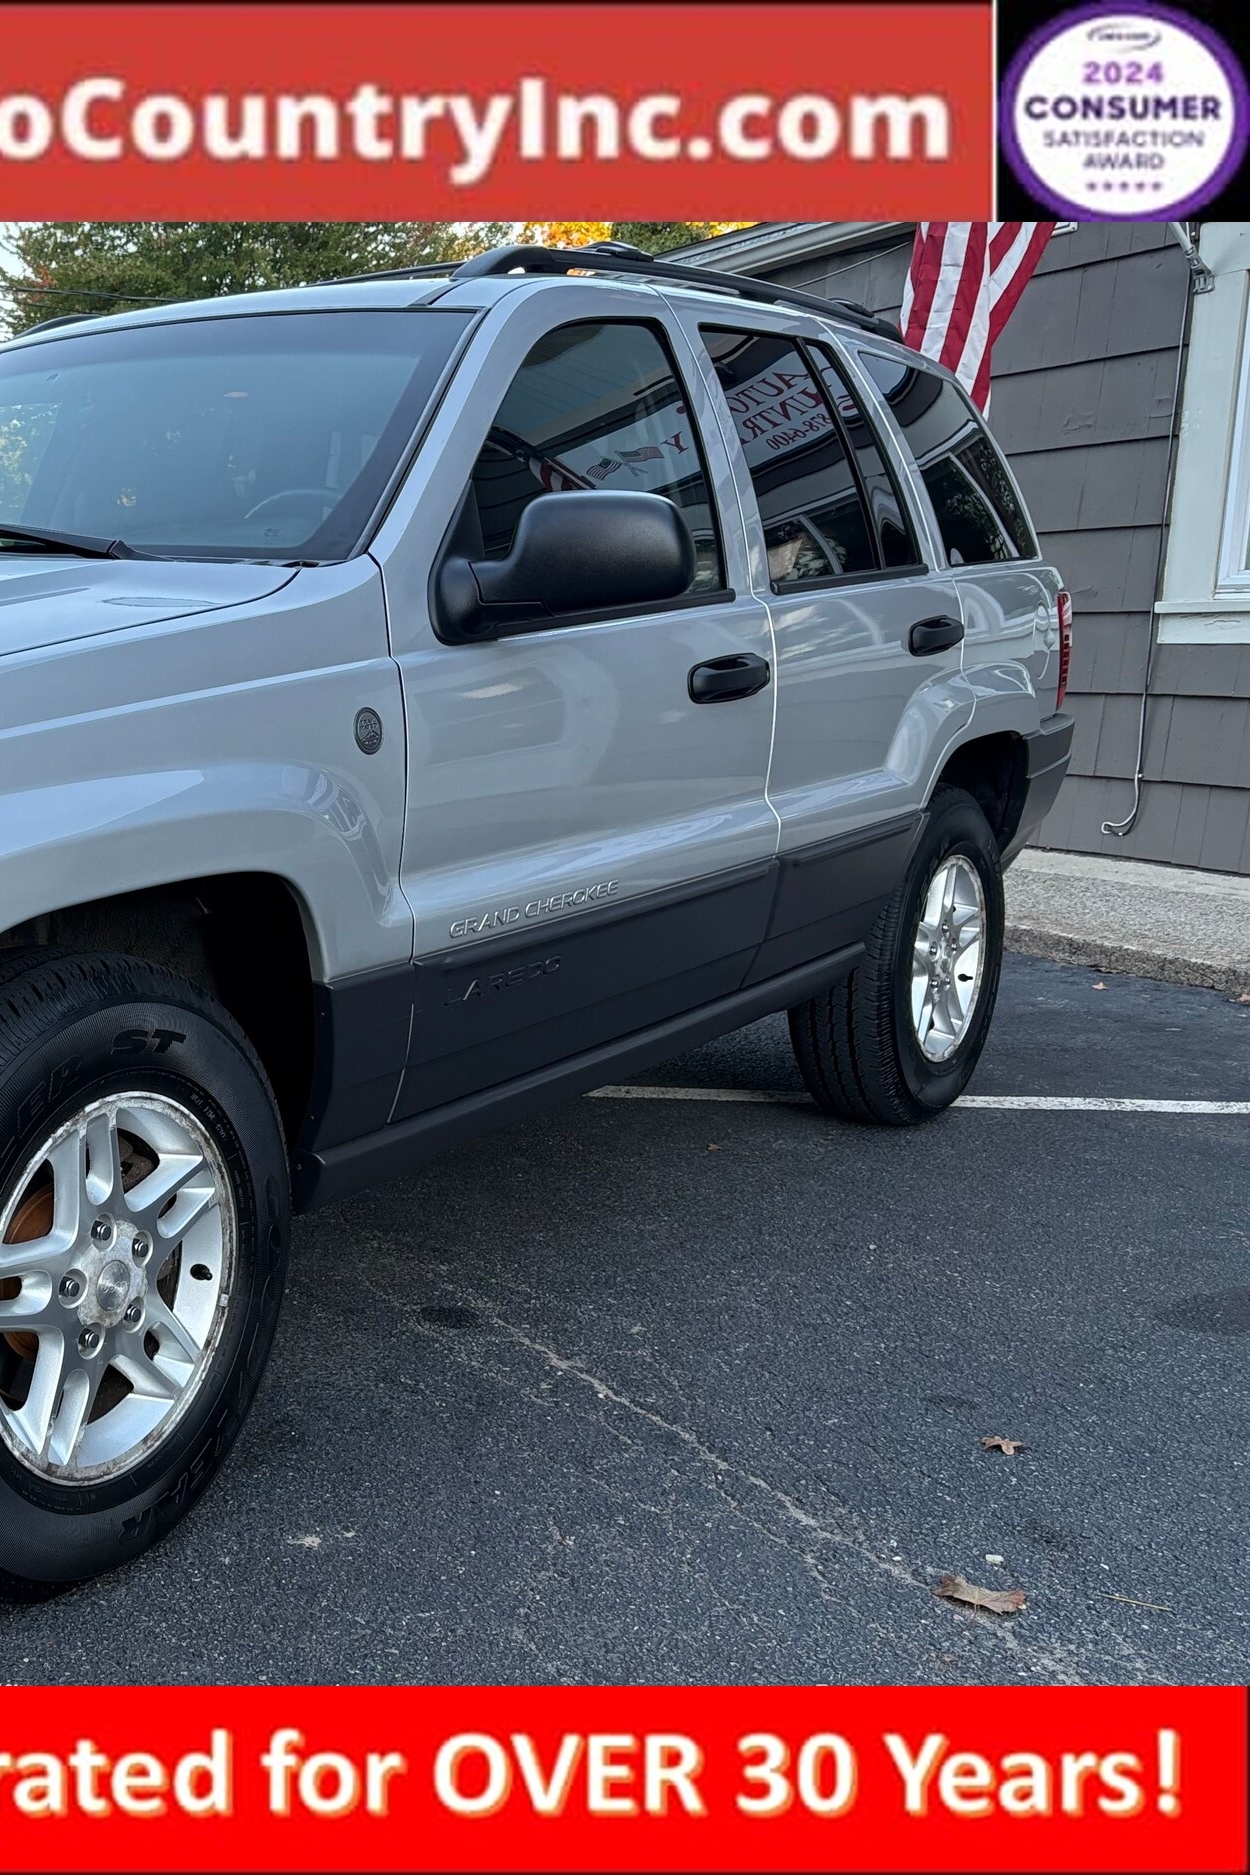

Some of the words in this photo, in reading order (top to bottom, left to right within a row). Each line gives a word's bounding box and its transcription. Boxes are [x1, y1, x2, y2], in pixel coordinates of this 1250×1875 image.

[450, 906, 520, 938] GRAND
[525, 879, 620, 919] CHEROKEE
[444, 954, 563, 1005] LAREDO
[110, 1029, 186, 1055] ST
